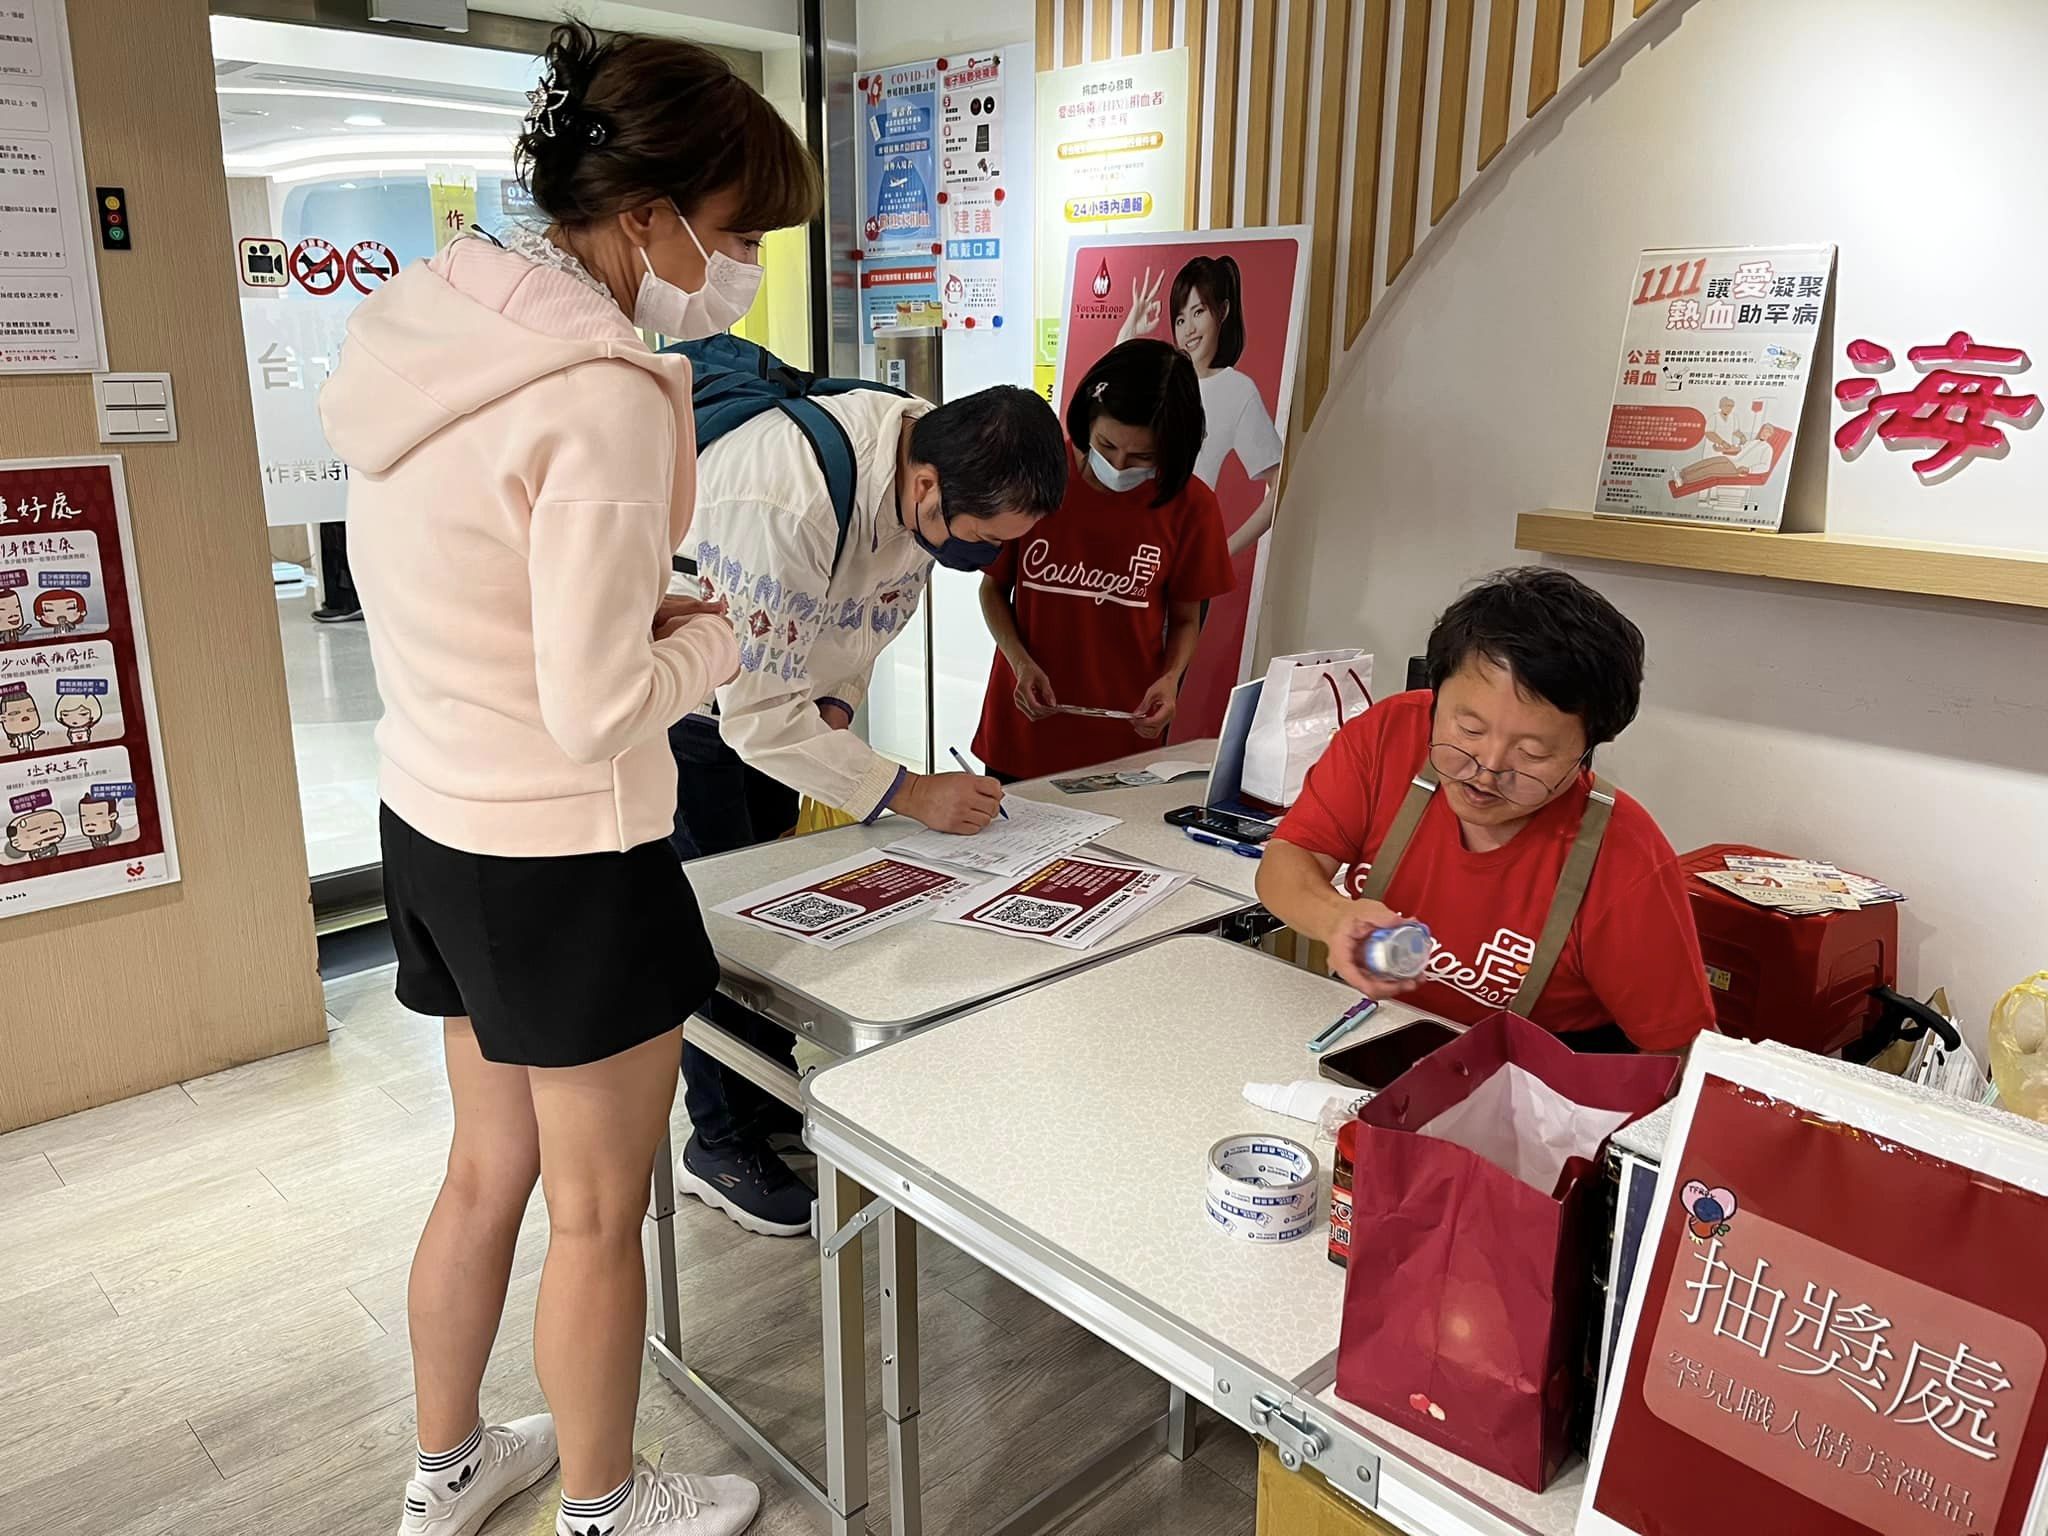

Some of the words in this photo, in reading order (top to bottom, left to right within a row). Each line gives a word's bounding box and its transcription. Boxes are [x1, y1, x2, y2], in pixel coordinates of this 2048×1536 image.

[891, 69, 936, 85] COVID-19
[1082, 78, 1133, 96] 捐血中心發現
[954, 208, 992, 234] 建議
[1633, 258, 1707, 306] 1111
[1707, 260, 1824, 300] 讓愛凝聚
[1665, 298, 1820, 331] 熱血助罕病
[1627, 350, 1661, 366] 公益
[1622, 370, 1658, 386] 捐血
[1834, 330, 2040, 474] 海
[1680, 1238, 2013, 1461] 抽獎處
[1668, 1350, 1976, 1528] 罕見職人精美禮品
